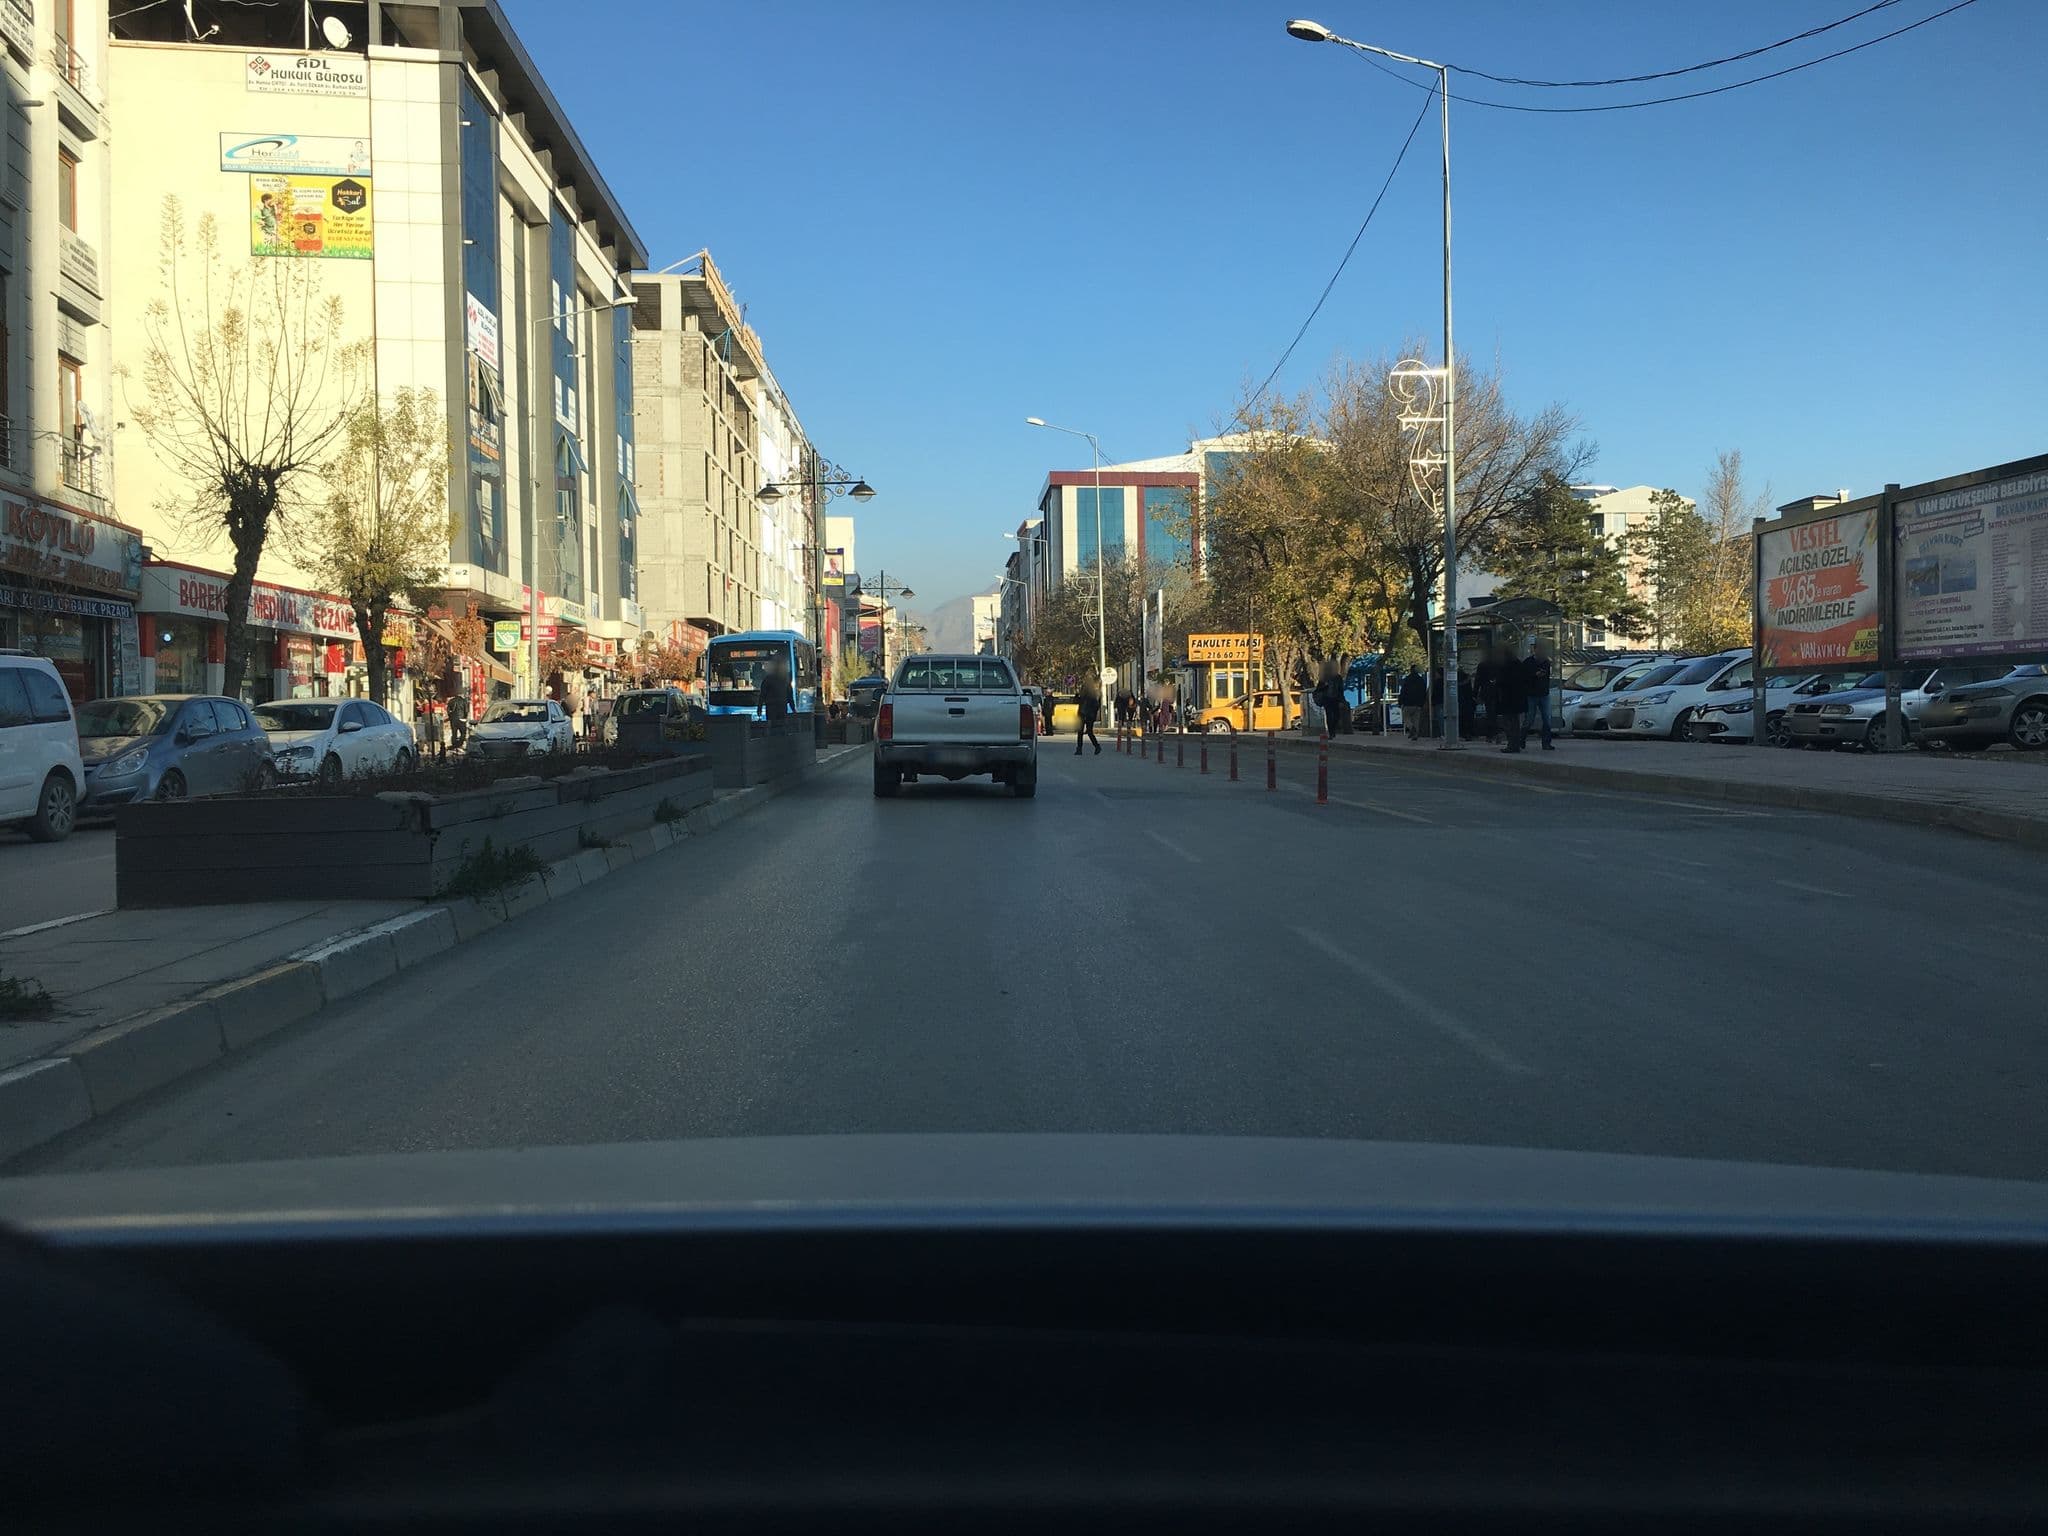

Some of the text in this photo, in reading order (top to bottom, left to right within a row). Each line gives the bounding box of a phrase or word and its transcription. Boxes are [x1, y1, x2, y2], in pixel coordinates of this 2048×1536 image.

[297, 58, 331, 69] ADL
[271, 69, 312, 81] HUKUK
[1919, 499, 1938, 515] VAN
[5, 498, 95, 556] KÖYLÜ
[1790, 520, 1842, 553] VESTEL
[179, 574, 229, 612] BÖREK
[99, 602, 130, 618] PAZARI
[1207, 651, 1221, 659] 216
[1223, 651, 1234, 659] 60
